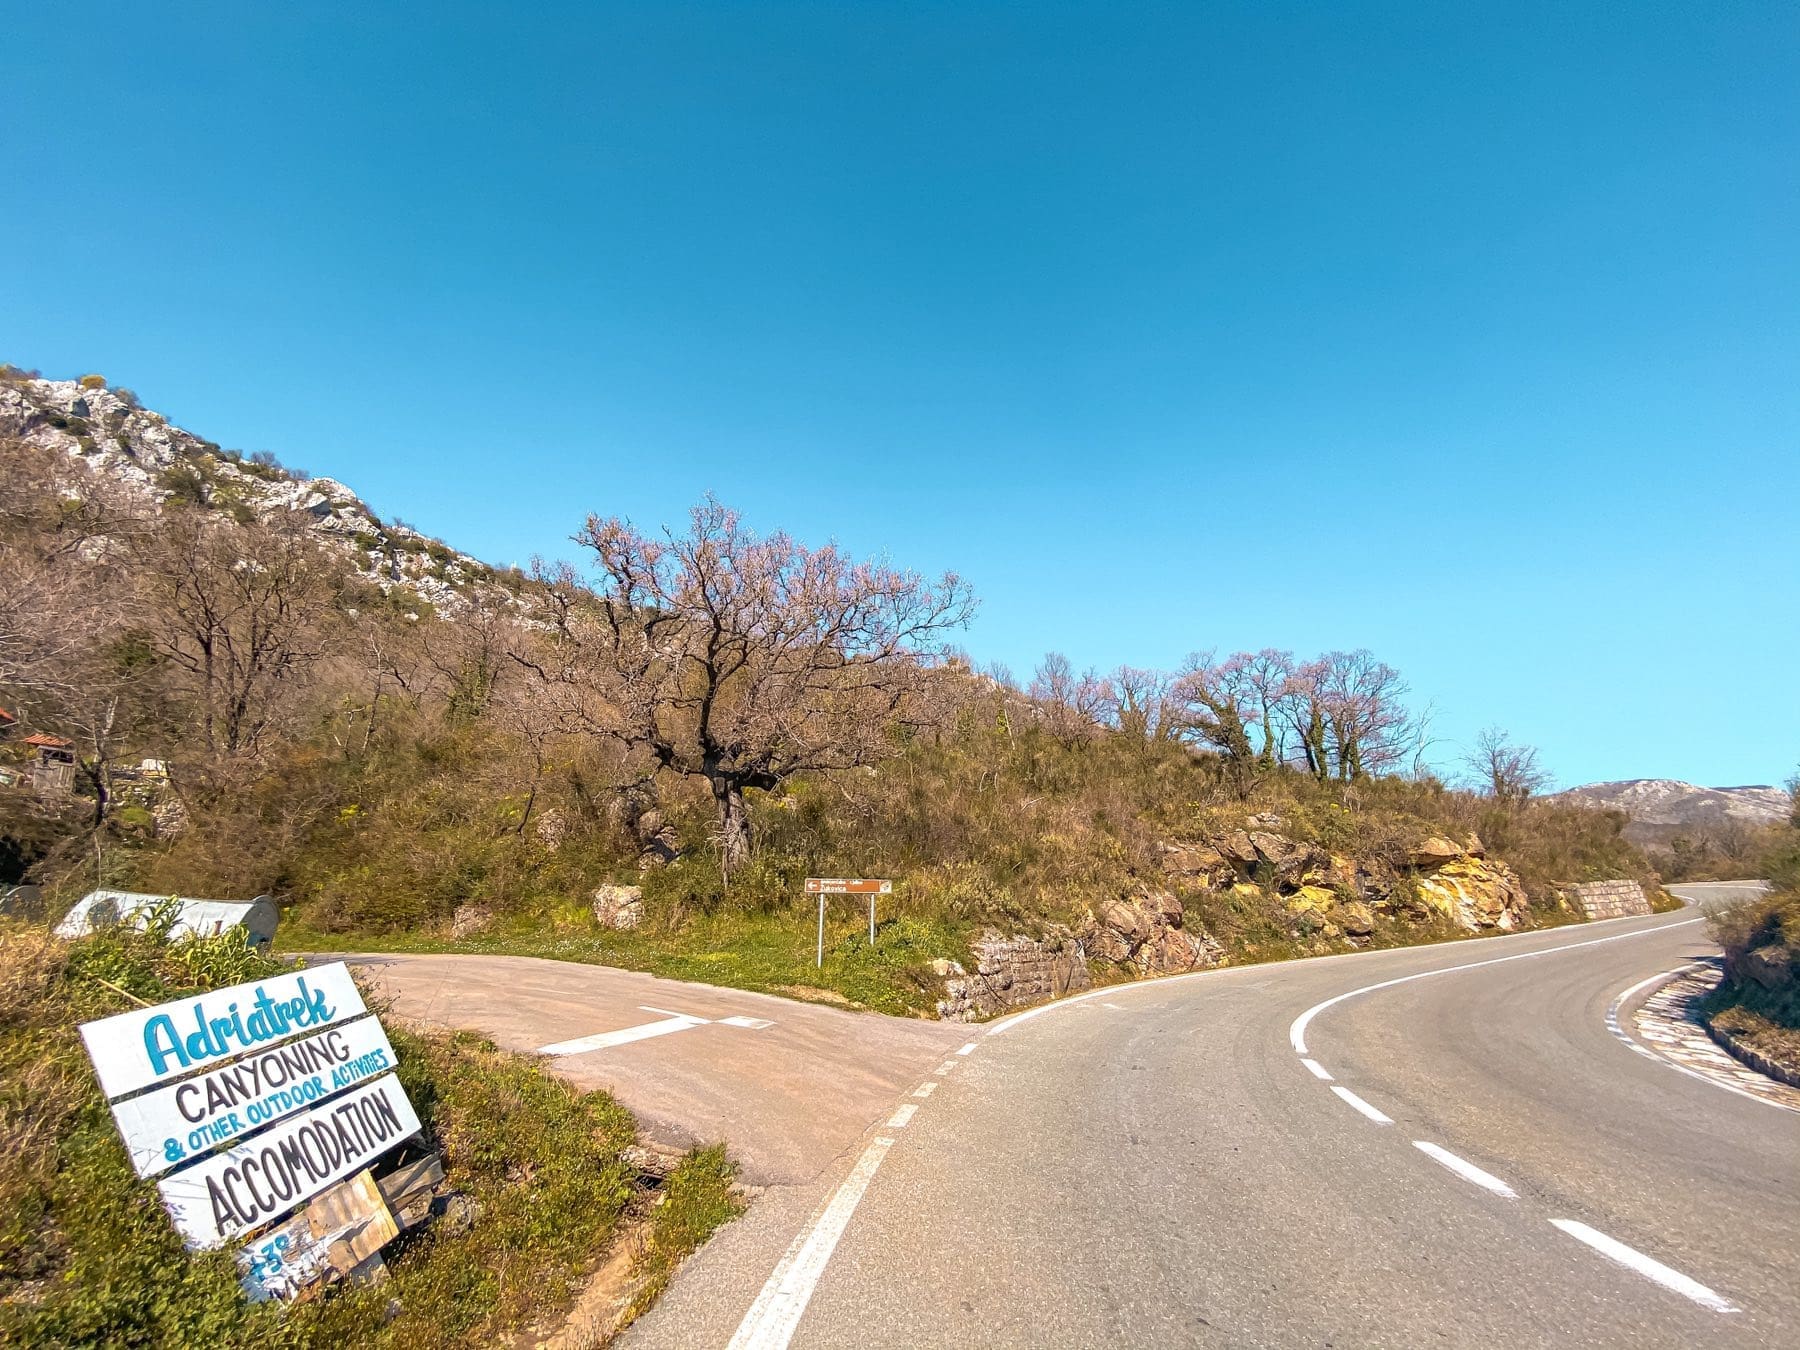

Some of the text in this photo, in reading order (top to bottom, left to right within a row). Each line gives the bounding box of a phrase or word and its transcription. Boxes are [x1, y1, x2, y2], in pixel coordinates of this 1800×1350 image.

[143, 976, 336, 1076] Adriatrek
[163, 1138, 186, 1162] &
[188, 1113, 247, 1150] OTHER
[248, 1077, 327, 1124] OUTDOOR
[176, 1030, 351, 1122] CANYONING
[205, 1088, 403, 1236] ACCOMODATION
